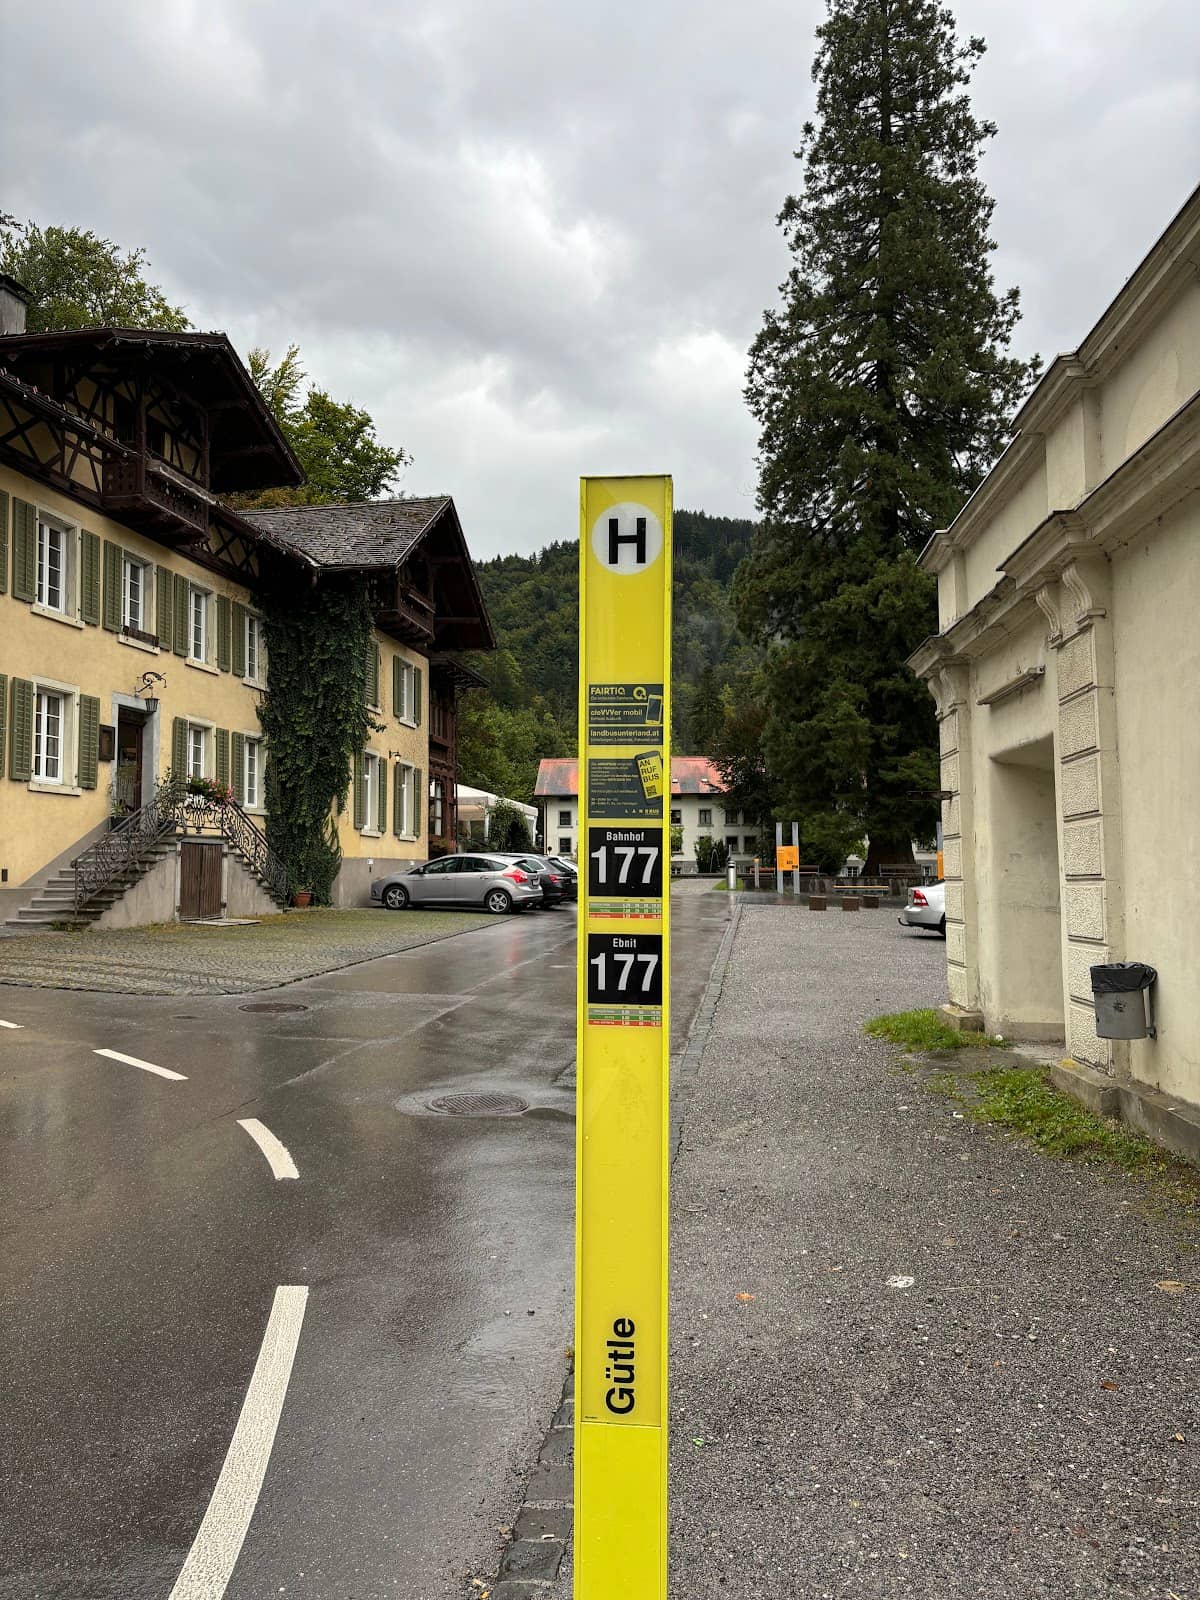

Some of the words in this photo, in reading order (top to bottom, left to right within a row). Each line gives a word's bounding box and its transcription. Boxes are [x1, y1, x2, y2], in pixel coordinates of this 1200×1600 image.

[609, 518, 646, 564] H
[590, 687, 625, 695] FAIRTIQ
[641, 766, 657, 775] RUF
[643, 774, 659, 783] BUS
[606, 831, 645, 841] Bahnhof
[591, 846, 658, 884] 177
[612, 938, 637, 948] Ebnit
[590, 953, 658, 992] 177
[606, 1318, 635, 1414] Gütle
